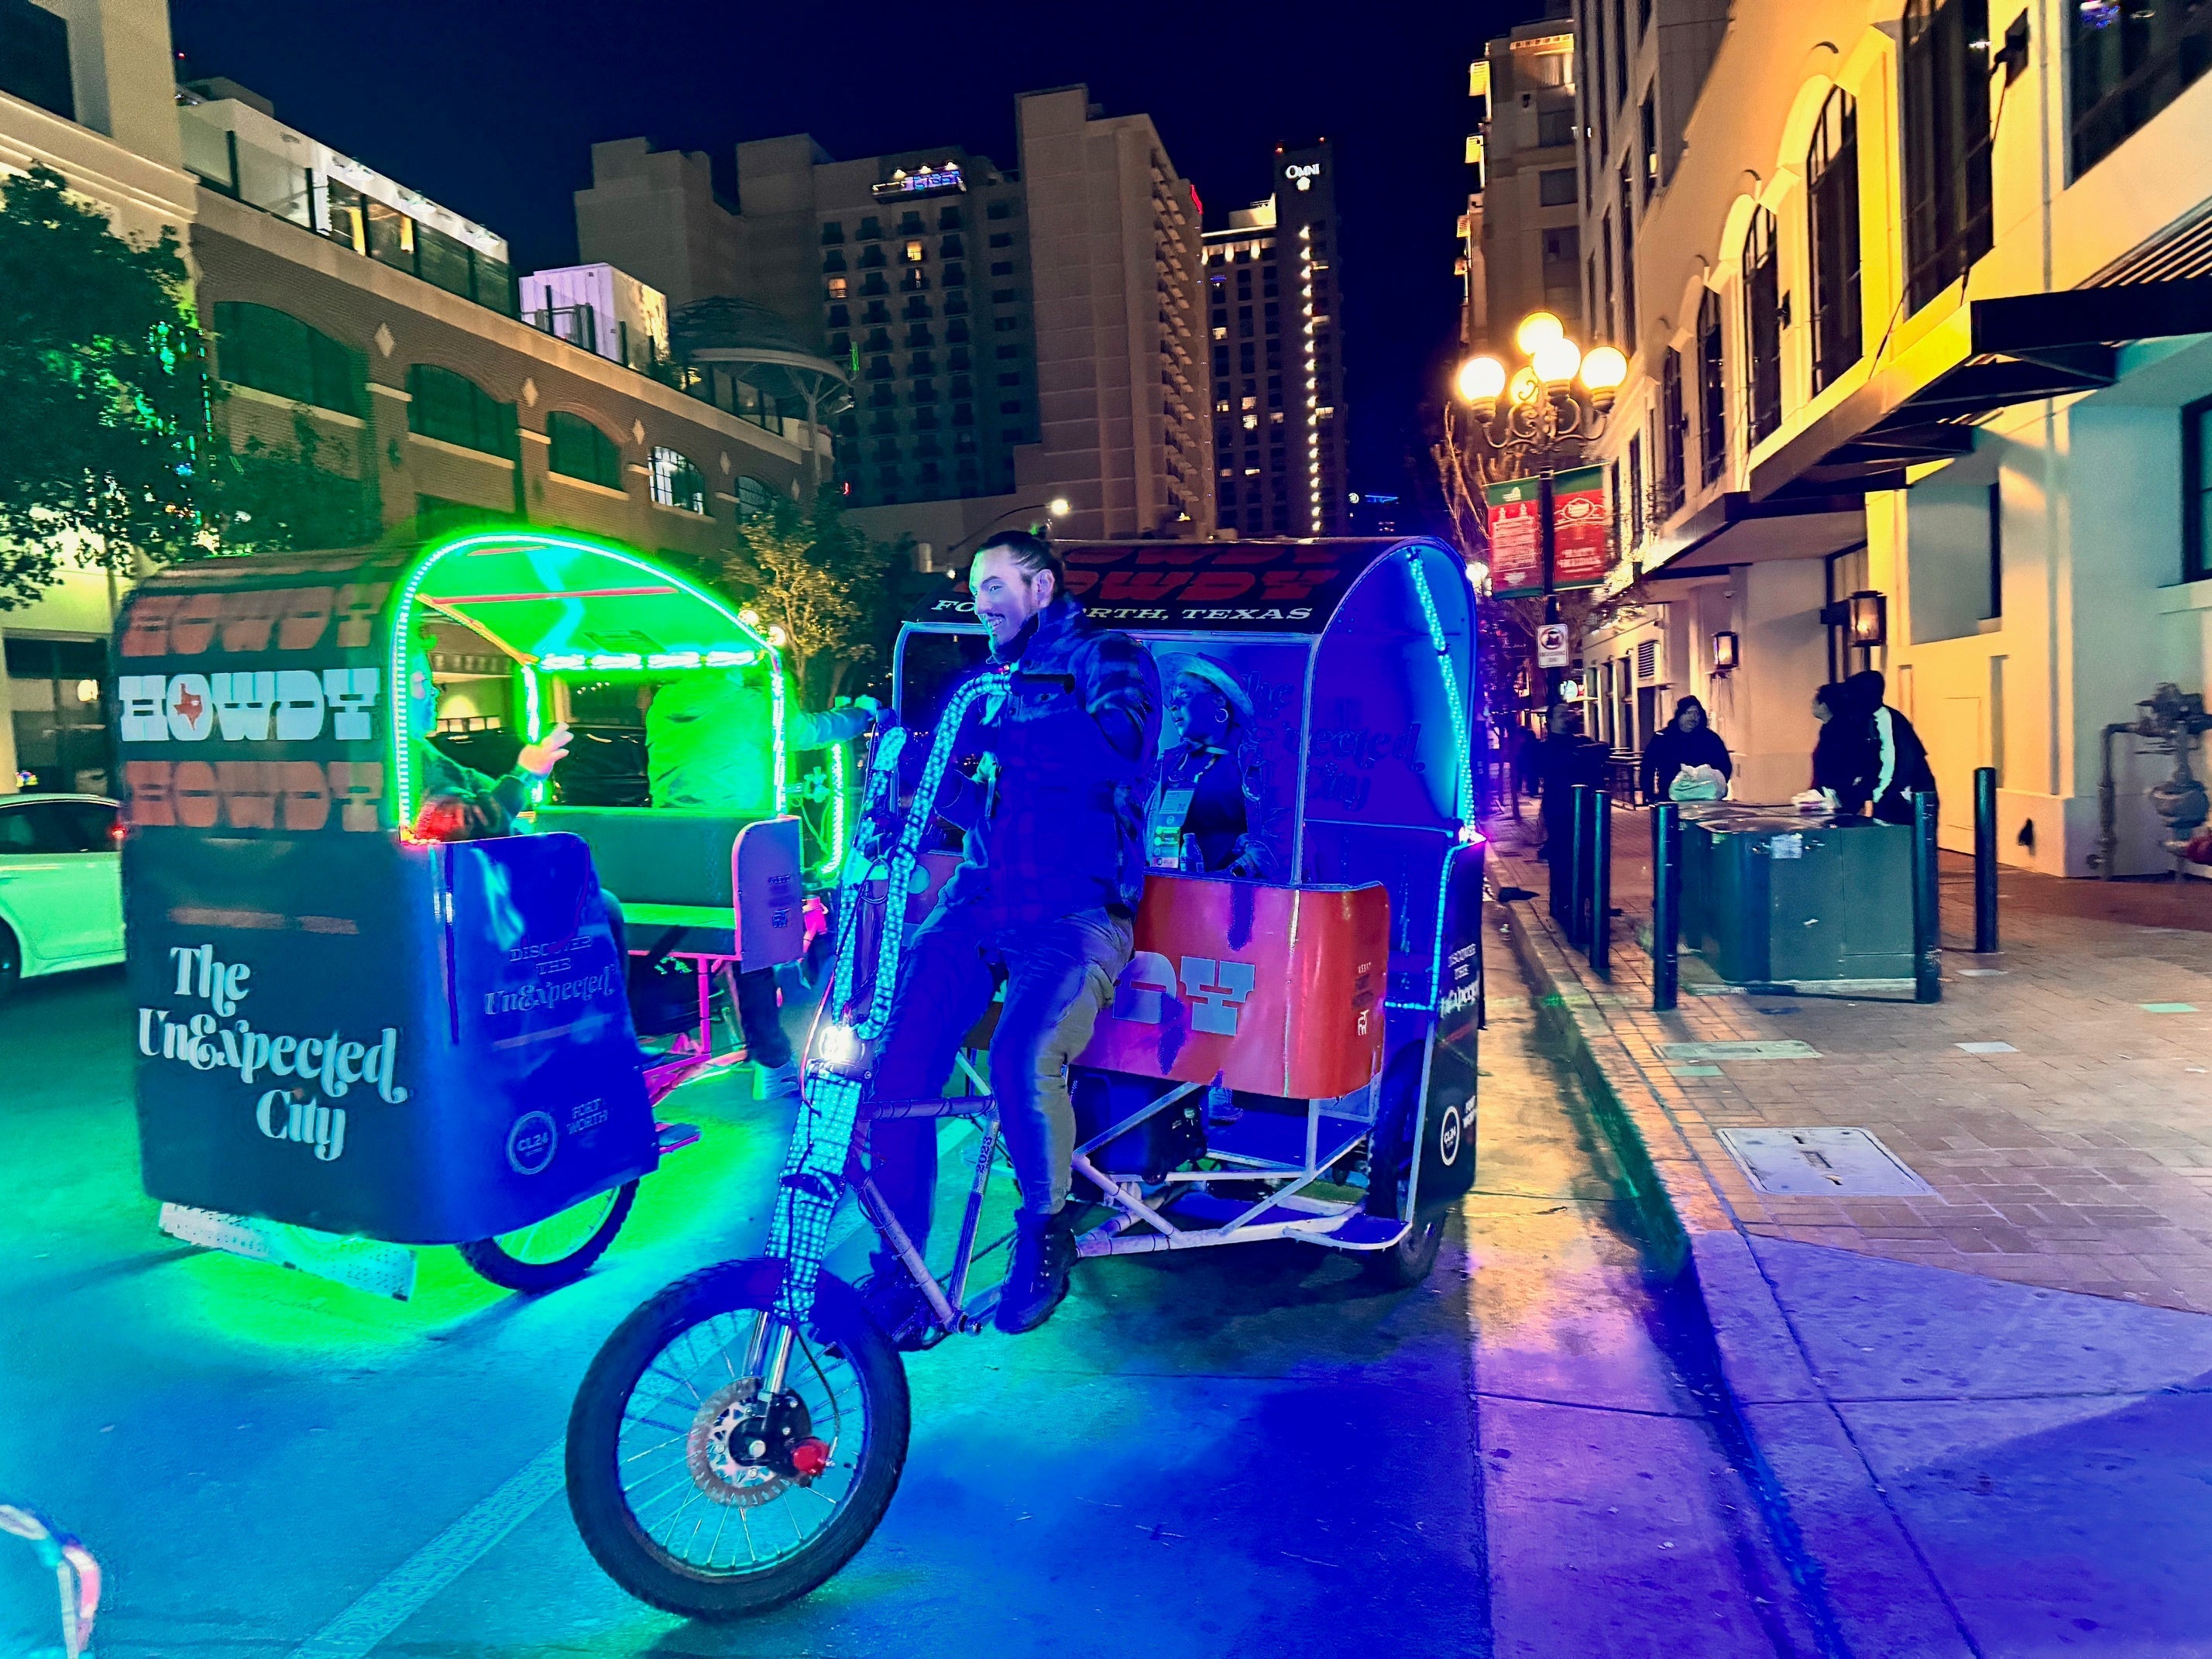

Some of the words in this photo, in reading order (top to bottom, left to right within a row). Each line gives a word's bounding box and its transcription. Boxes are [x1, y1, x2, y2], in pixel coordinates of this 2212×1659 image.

[1181, 608, 1313, 620] TEXAS
[118, 668, 381, 742] HOWDY
[126, 761, 383, 832] HOWDY
[170, 943, 251, 1017] The
[256, 1088, 347, 1161] City
